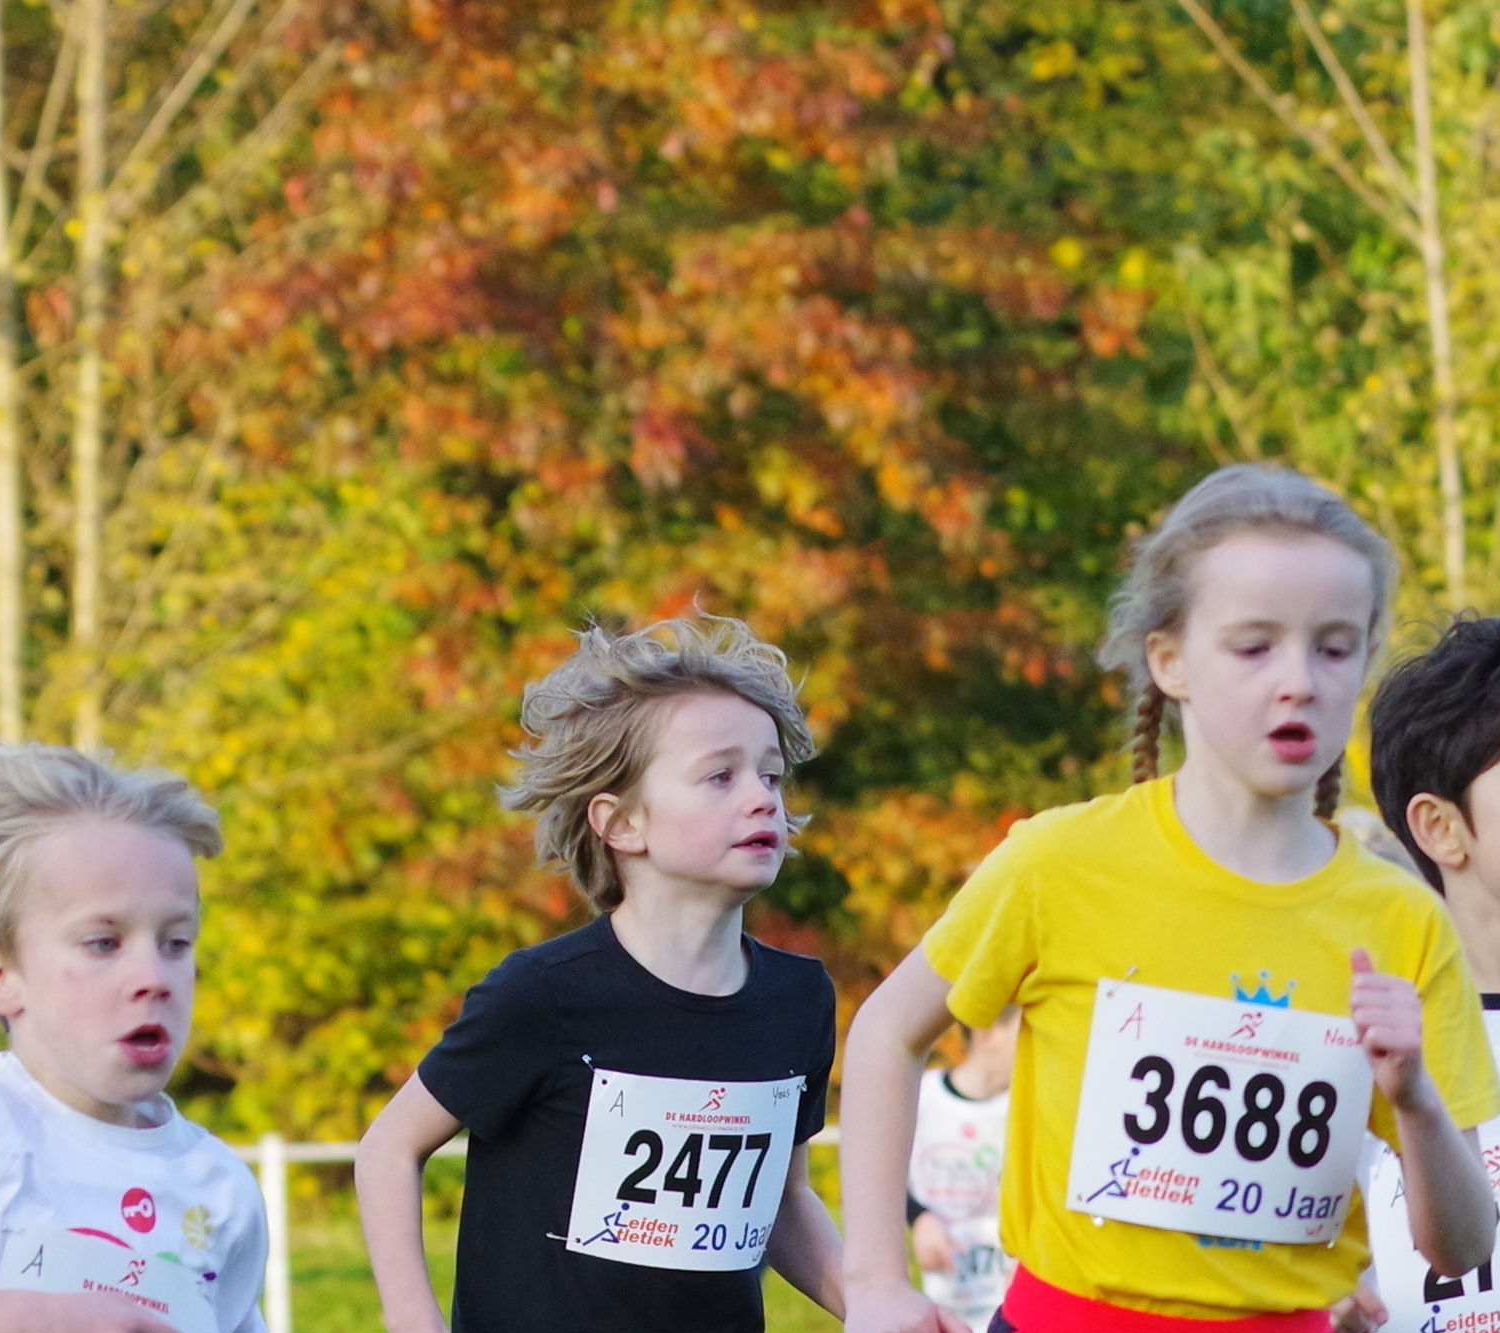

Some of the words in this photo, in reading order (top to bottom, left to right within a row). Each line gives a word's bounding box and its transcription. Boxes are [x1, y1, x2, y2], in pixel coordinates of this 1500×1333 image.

[1118, 1002, 1143, 1040] A
[1202, 1039, 1300, 1063] HARDLOOPWINKEL
[609, 1090, 624, 1117] A
[665, 1111, 676, 1121] DE
[679, 1113, 751, 1124] HARDLOOPWINKEL
[1123, 1055, 1337, 1168] 3688
[616, 1129, 773, 1209] 2477
[1122, 1158, 1200, 1188] Leiden
[1215, 1179, 1263, 1214] 20
[1274, 1187, 1344, 1219] Jaar
[613, 1211, 679, 1234] Leiden
[691, 1223, 727, 1251] 20
[20, 1243, 44, 1278] A
